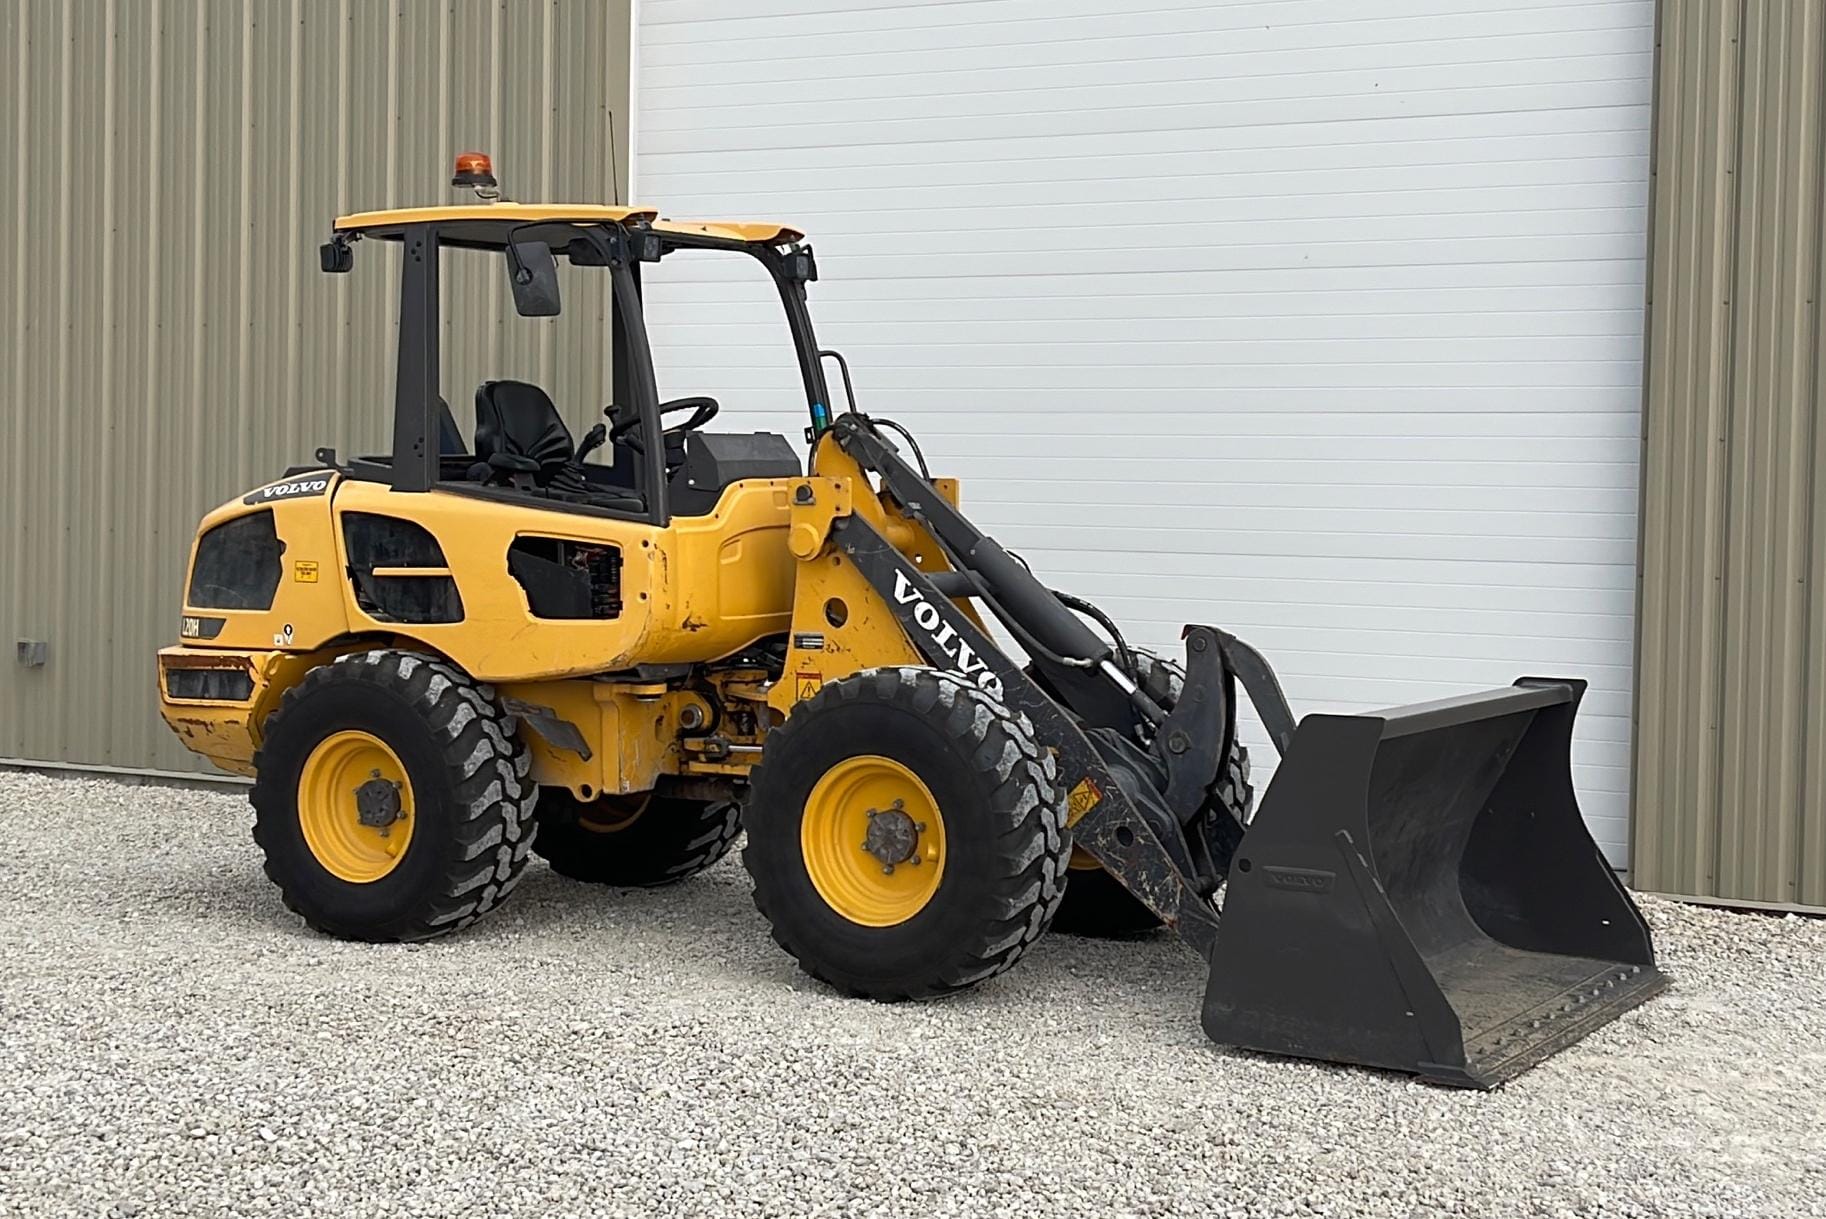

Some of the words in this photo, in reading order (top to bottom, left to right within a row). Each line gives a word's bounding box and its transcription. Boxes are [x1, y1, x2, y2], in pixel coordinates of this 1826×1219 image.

[263, 480, 327, 498] VOLVO
[182, 617, 200, 637] L20H
[894, 568, 1004, 702] VOLVO
